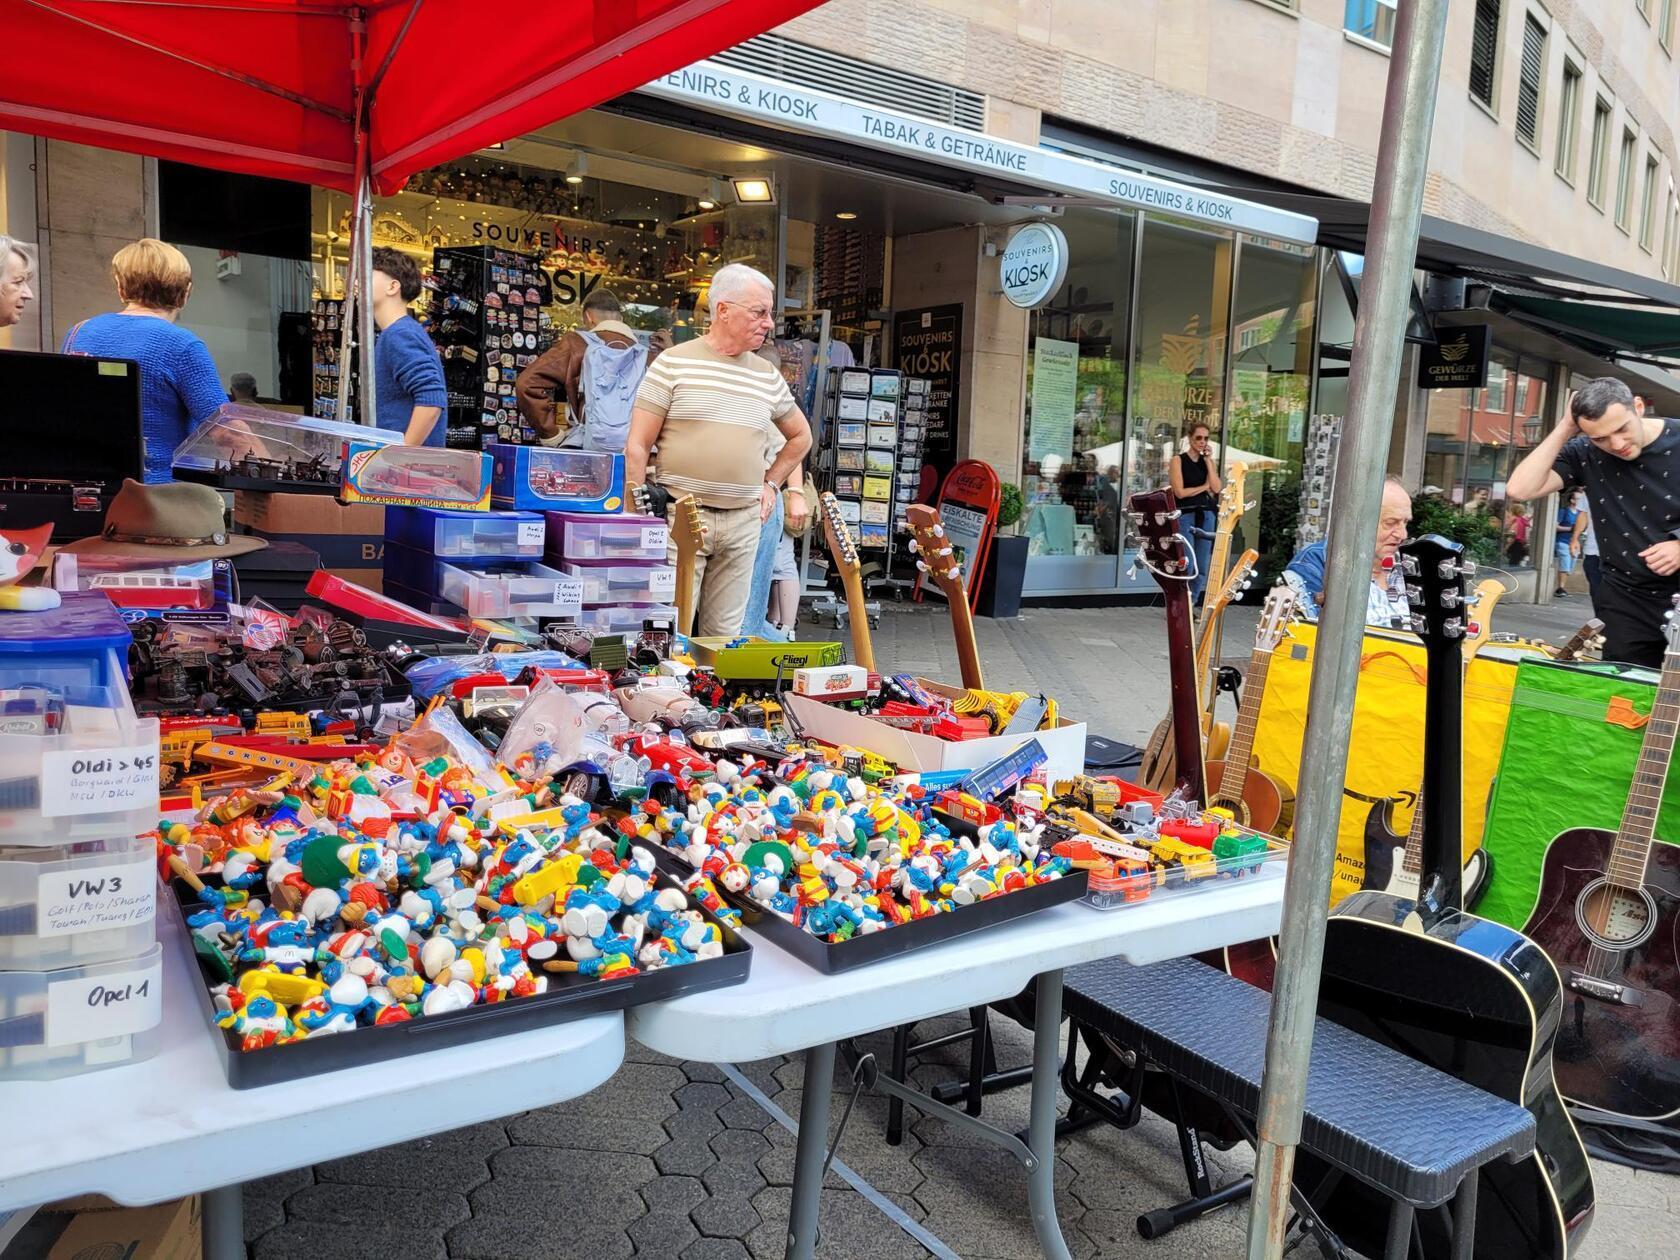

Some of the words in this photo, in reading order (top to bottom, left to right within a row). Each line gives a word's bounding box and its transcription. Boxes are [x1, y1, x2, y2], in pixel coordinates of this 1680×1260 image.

[738, 85, 751, 104] &
[758, 90, 818, 120] KIOSK
[862, 115, 920, 145] TABAK
[925, 132, 936, 149] &
[942, 136, 1027, 170] GETRÄNKE
[1109, 180, 1183, 209] SOUVENIRS
[1185, 197, 1194, 212] &
[1197, 200, 1233, 220] KIOSK
[473, 222, 606, 255] SOUVENIRS
[1004, 244, 1052, 261] SOUVENIRS
[1005, 262, 1049, 288] KIOSK
[902, 331, 953, 347] SOUVENIRS
[901, 351, 952, 374] KIOSK
[1428, 363, 1478, 375] GEWÜRZE
[943, 505, 984, 524] EISKALTE
[783, 655, 808, 666] Fliegl
[72, 759, 112, 774] Oldi
[134, 756, 155, 770] 45
[925, 781, 941, 793] Alles
[1336, 853, 1366, 870] Amaz
[69, 879, 105, 899] VW
[108, 877, 122, 893] 3
[88, 983, 131, 1007] Opel
[136, 979, 149, 998] 1
